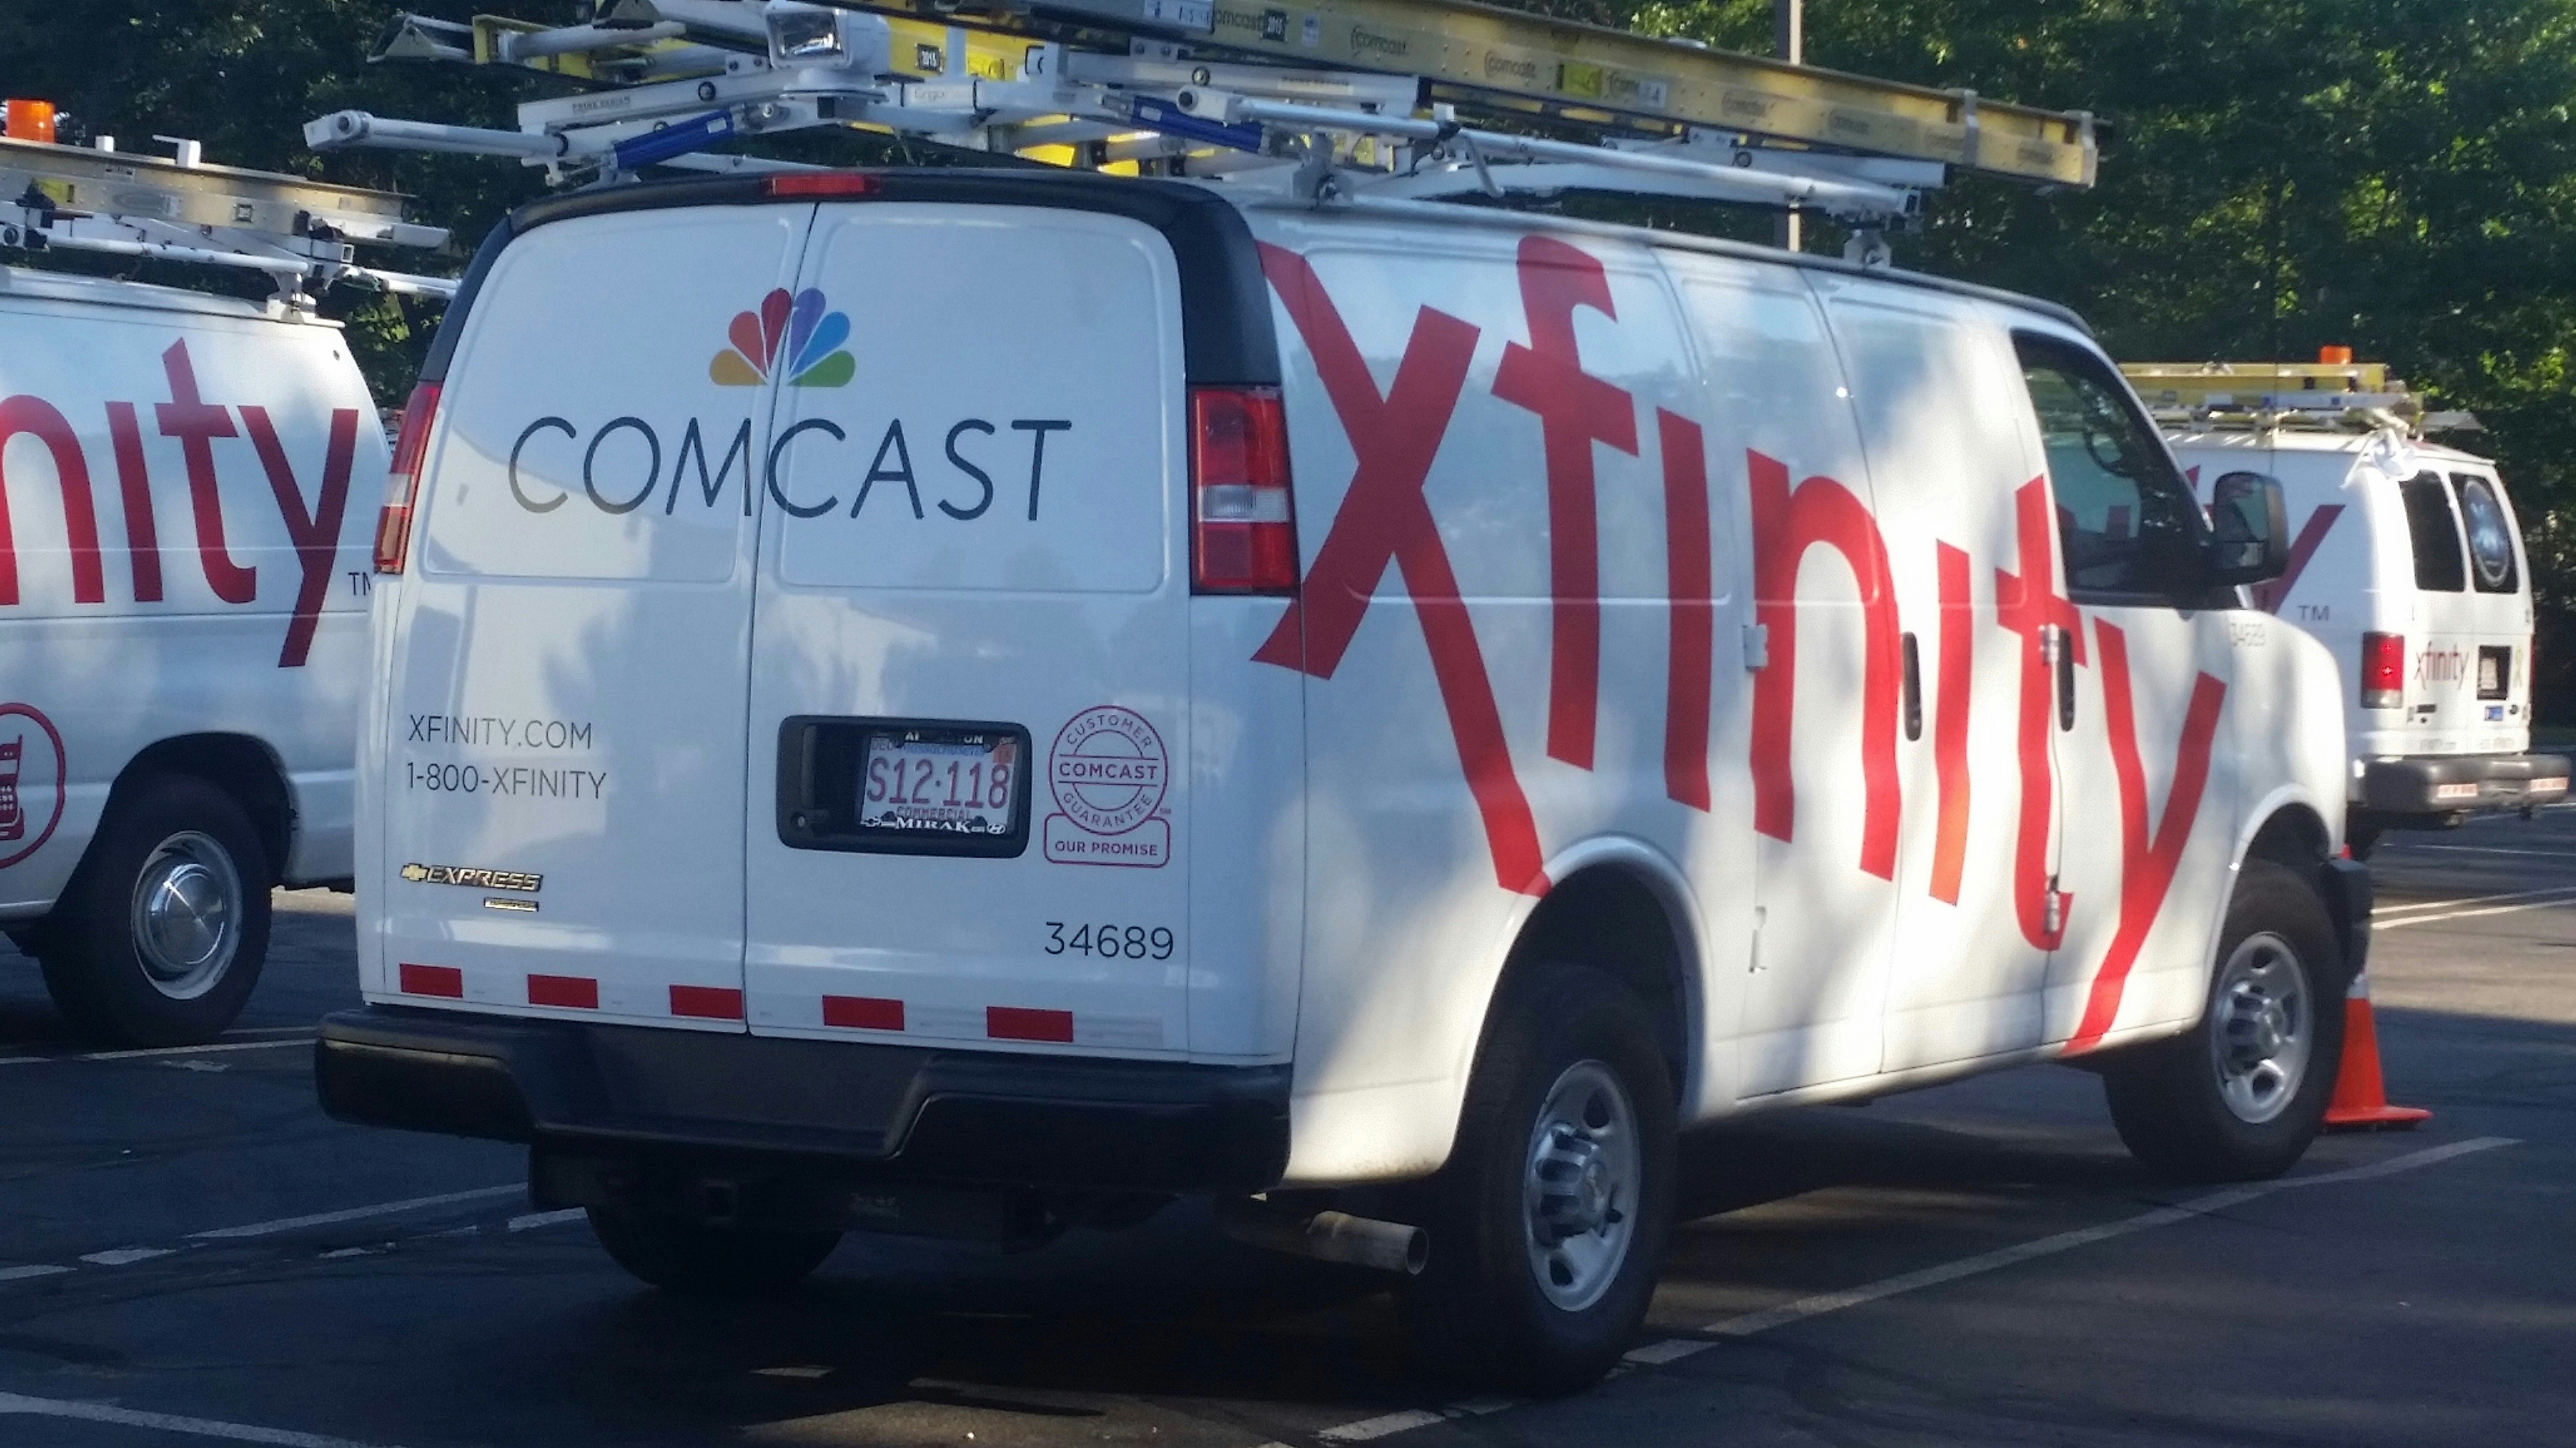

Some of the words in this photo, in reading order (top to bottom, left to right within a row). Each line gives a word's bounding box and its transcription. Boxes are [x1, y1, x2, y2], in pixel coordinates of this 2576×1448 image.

[508, 415, 1072, 520] COMCAST
[2297, 605, 2330, 621] TM
[1252, 237, 2226, 1055] xfinity
[2414, 641, 2469, 690] xfinity
[408, 714, 592, 749] XFINITY.COM
[1066, 714, 1153, 748] CUSTOMER
[407, 762, 606, 799] 1-800-XFINITY
[1059, 762, 1158, 780] COMCAST
[895, 816, 972, 834] MIRAK
[1063, 792, 1153, 828] GUARANTEE
[1055, 840, 1085, 853] OUR
[1092, 841, 1158, 856] PROMISE
[427, 865, 543, 892] EXPRESS
[1045, 921, 1175, 961] 34689
